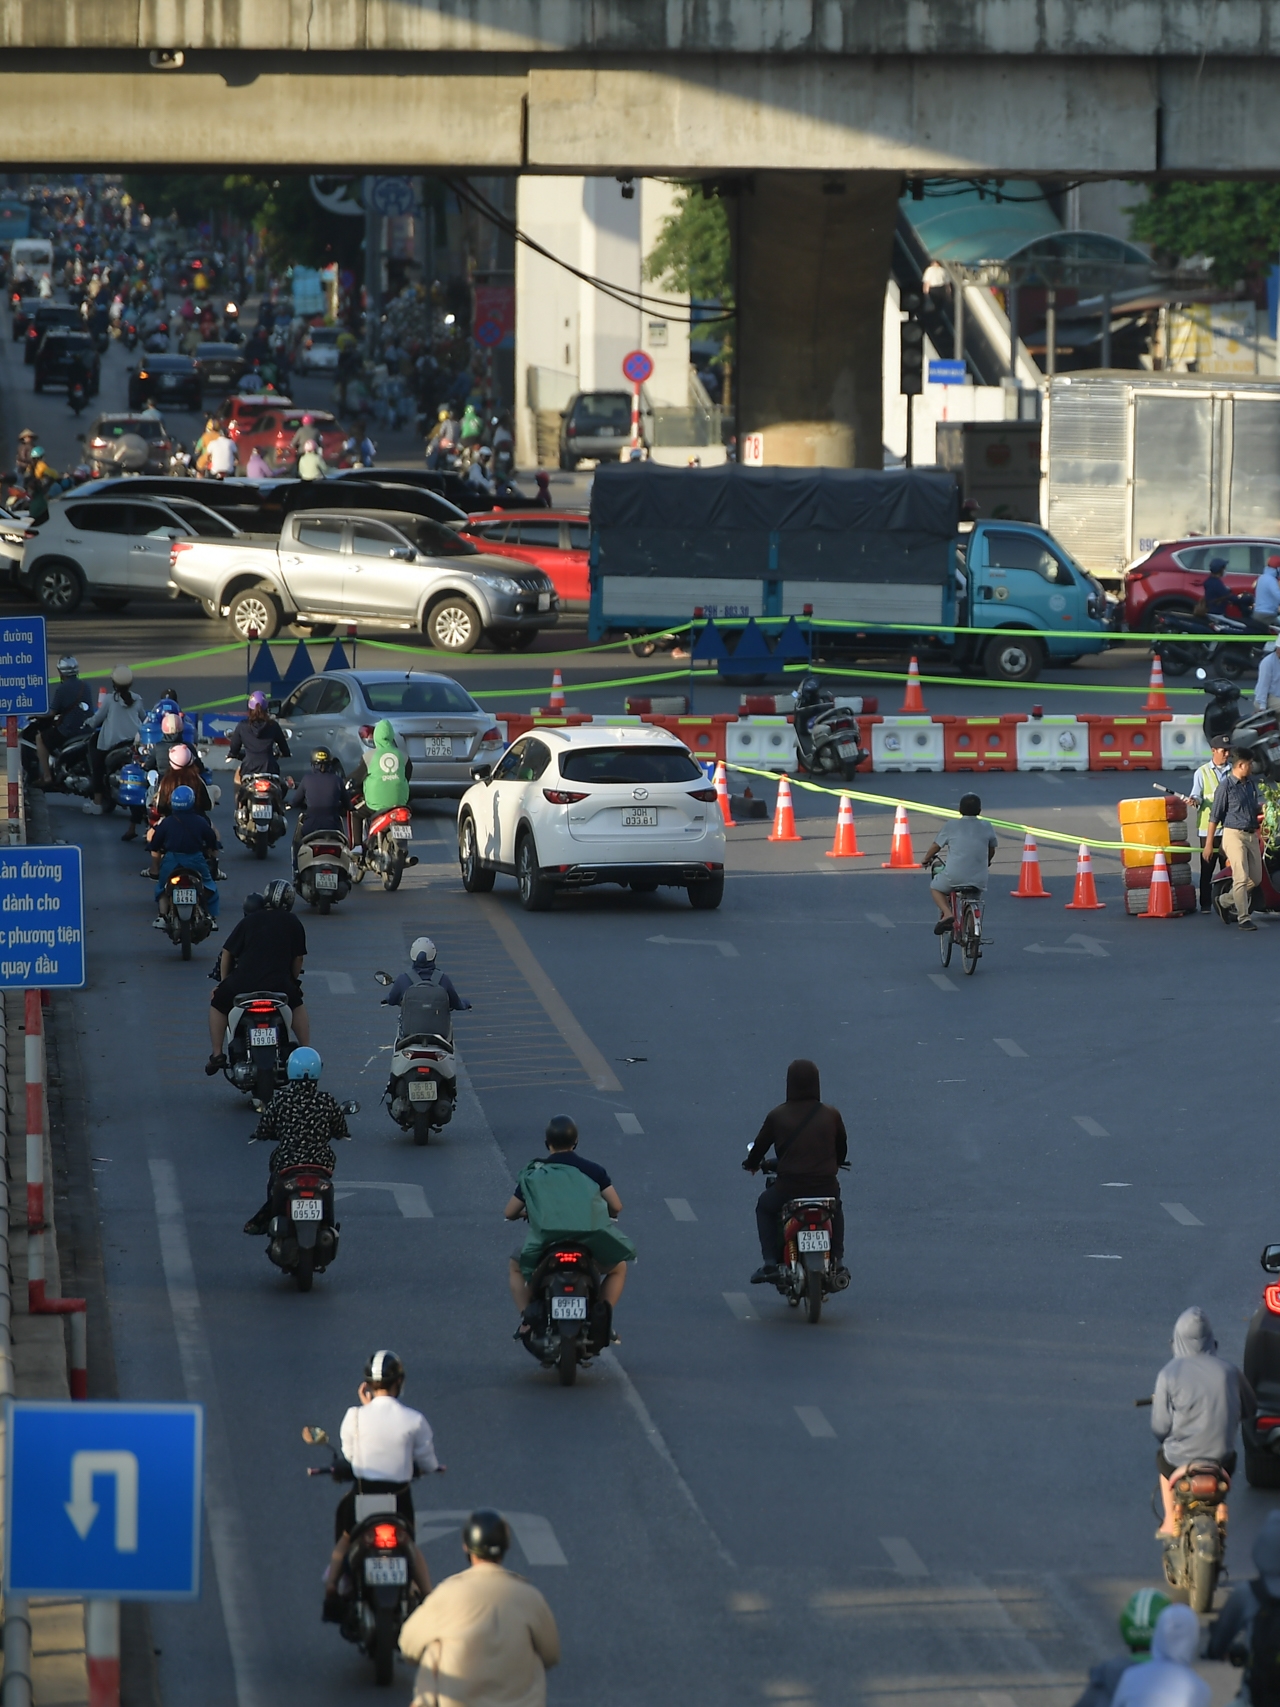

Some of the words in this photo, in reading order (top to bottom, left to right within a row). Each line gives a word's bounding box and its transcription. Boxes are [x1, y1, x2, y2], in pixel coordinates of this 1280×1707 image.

[4, 628, 33, 644] đường
[16, 652, 32, 664] cho
[27, 674, 43, 687] tiện
[16, 693, 32, 707] đầu
[632, 808, 647, 816] 30H
[625, 817, 653, 825] 033.81
[0, 860, 17, 879] àn
[21, 860, 62, 882] đường
[3, 893, 34, 911] dành
[37, 893, 60, 910] cho
[8, 926, 55, 949] phương
[58, 925, 80, 945] tiện
[1, 960, 31, 979] quay
[35, 953, 58, 974] đầu
[253, 1036, 275, 1045] 199.06
[296, 1200, 317, 1209] 37-G1
[293, 1209, 321, 1219] 095.57
[802, 1231, 825, 1240] 29-G1
[800, 1240, 828, 1251] 334.50
[554, 1307, 584, 1317] 619.47
